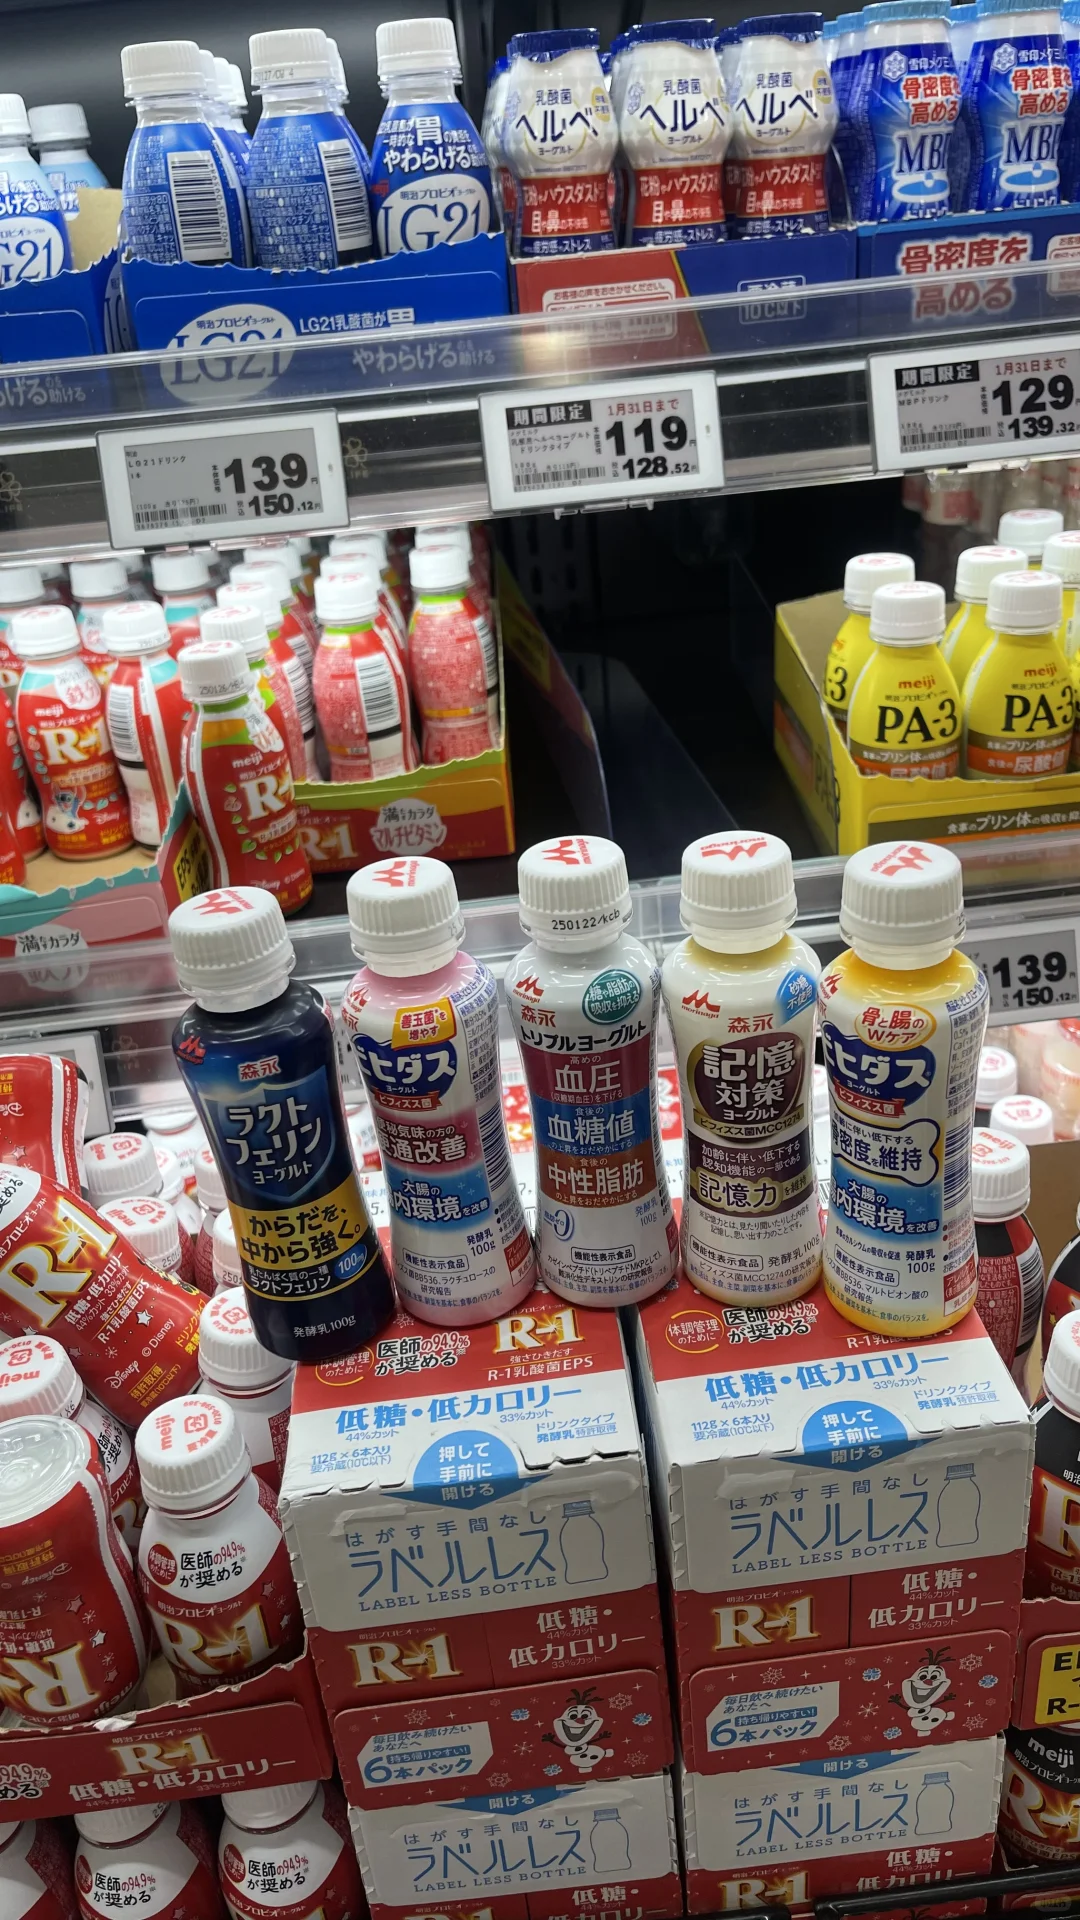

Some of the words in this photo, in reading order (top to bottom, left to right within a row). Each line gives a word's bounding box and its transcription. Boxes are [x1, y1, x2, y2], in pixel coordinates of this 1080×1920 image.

[663, 78, 702, 96] 乳酸菌
[756, 72, 793, 90] 乳酸菌
[536, 88, 572, 106] 乳酸菌
[735, 89, 819, 125] ヘルベ
[1019, 92, 1070, 116] 高める
[515, 107, 599, 143] ヘルベ
[639, 97, 726, 133] ヘルベ
[911, 101, 961, 125] 高める
[537, 145, 574, 157] ヨーグルト
[667, 134, 703, 147] ヨーグルト
[901, 235, 1029, 275] 骨密度を
[915, 278, 1014, 319] 高める
[901, 363, 973, 387] 期間限定
[995, 356, 1067, 376] 1月31日まで
[607, 397, 680, 417] 1月31日まで
[992, 374, 1074, 416] 129
[512, 404, 586, 427] 期間限定
[1008, 415, 1076, 440] 139.32
[605, 415, 689, 457] 119
[224, 452, 308, 495] 139
[622, 455, 690, 480] 128.52
[247, 492, 314, 517] 150.12
[1023, 663, 1058, 678] meiji
[898, 676, 936, 692] meiji
[874, 697, 959, 745] PA-3
[1001, 685, 1075, 733] PA-3
[372, 821, 445, 848] マルチビタミン
[551, 908, 621, 931] 250122/kcb
[992, 951, 1068, 989] 139
[520, 1003, 557, 1028] 森永
[681, 1005, 720, 1019] morinaga
[727, 1013, 774, 1034] 森永
[861, 1006, 925, 1030] 骨と腸の
[409, 1025, 439, 1041] 増やす
[520, 1020, 647, 1052] トリプルヨーグルト
[867, 1028, 918, 1044] Wケア
[240, 1056, 281, 1081] 森永
[569, 1055, 602, 1065] 高めの
[702, 1039, 797, 1081] 記憶
[554, 1060, 621, 1093] 血圧
[379, 1094, 433, 1110] ビフィズス菌
[715, 1078, 785, 1108] 対策
[838, 1086, 896, 1115] ビフィズス菌
[228, 1096, 309, 1136] ラクト
[574, 1106, 605, 1116] 食後の
[723, 1107, 780, 1121] ヨーグルト
[547, 1109, 636, 1146] 血糖値
[226, 1116, 322, 1166] フェリン
[701, 1139, 801, 1164] 加齢に伴い低下する
[252, 1160, 313, 1185] ヨーグルト
[579, 1157, 608, 1167] 食後の
[402, 1180, 441, 1198] 大腸の
[547, 1158, 644, 1196] 中性脂肪
[784, 1176, 807, 1196] を維持
[698, 1173, 778, 1209] 記憶力
[848, 1180, 888, 1204] 大腸の
[248, 1203, 348, 1238] からだを、
[240, 1219, 362, 1265] 中から強く。
[466, 1227, 494, 1246] 発酵乳
[470, 1241, 497, 1257] 100g
[404, 1251, 466, 1271] 機能性表示食品
[691, 1239, 760, 1268] 機能性表示食品
[767, 1247, 804, 1268] 発酵乳
[905, 1248, 936, 1261] 発酵乳
[836, 1250, 896, 1283] 機能性表示食品
[907, 1262, 936, 1274] 100g
[250, 1276, 331, 1296] ラクトフェリン
[843, 1283, 874, 1305] 研究報告
[96, 1277, 151, 1345] R-1乳酸菌EPS
[668, 1319, 720, 1337] 体調管理
[375, 1350, 458, 1377] が奨める
[509, 1347, 574, 1364] 強さひきだす
[325, 1365, 364, 1378] のために
[704, 1351, 950, 1403] 低糖・低カロリー
[873, 1374, 928, 1390] 33%カット
[913, 1380, 992, 1400] ドリンクタイプ
[336, 1384, 582, 1435] 低糖・低カロリー
[499, 1408, 554, 1424] 33%カット
[535, 1411, 616, 1433] ドリンクタイプ
[821, 1409, 874, 1429] 押して
[155, 1413, 177, 1451] meiji
[345, 1427, 400, 1443] 44%カット
[827, 1425, 882, 1446] 手前に
[438, 1442, 490, 1463] 押して
[830, 1445, 884, 1465] 開ける
[438, 1460, 493, 1484] 手前に
[441, 1482, 496, 1502] 開ける
[729, 1472, 930, 1511] はがす手間なし
[730, 1490, 930, 1560] ラベルレス
[180, 1540, 246, 1572] 医師の94.9%
[348, 1527, 557, 1598] ラベルレス
[732, 1557, 793, 1575] LABEL
[799, 1550, 844, 1566] LESS
[851, 1538, 929, 1559] BOTTLE
[179, 1560, 244, 1590] が奨める
[901, 1567, 979, 1595] 低糖・
[359, 1594, 421, 1613] LABEL
[427, 1588, 473, 1604] LESS
[480, 1575, 558, 1597] BOTTLE
[712, 1595, 822, 1653] R-1
[867, 1596, 1006, 1630] 低カロリー
[346, 1633, 465, 1689] R-1
[508, 1632, 647, 1670] 低カロリー
[723, 1683, 824, 1706] 毎日飲み続けたい
[723, 1700, 772, 1714] あなたへ
[372, 1723, 473, 1745] 毎日飲み続けたい
[709, 1718, 819, 1748] 6本パック
[110, 1732, 221, 1778] R-1
[372, 1739, 424, 1753] あなたへ
[1027, 1736, 1075, 1767] meiji
[363, 1755, 475, 1784] 6本パック
[823, 1757, 870, 1774] 開ける
[68, 1757, 297, 1802] 低糖・低カロリー
[488, 1792, 536, 1810] 開ける
[403, 1815, 580, 1846] はがす手間なし
[735, 1793, 910, 1848] ラベルレス
[735, 1842, 789, 1858] LABEL
[795, 1836, 834, 1851] LESS
[839, 1828, 908, 1845] BOTTLE
[248, 1853, 310, 1879] 医師の94.9%
[406, 1829, 587, 1883] ラベルレス
[247, 1871, 307, 1894] が奨める
[413, 1879, 467, 1893] LABEL
[473, 1873, 512, 1888] LESS
[519, 1865, 587, 1882] BOTTLE
[93, 1889, 152, 1909] が奨める
